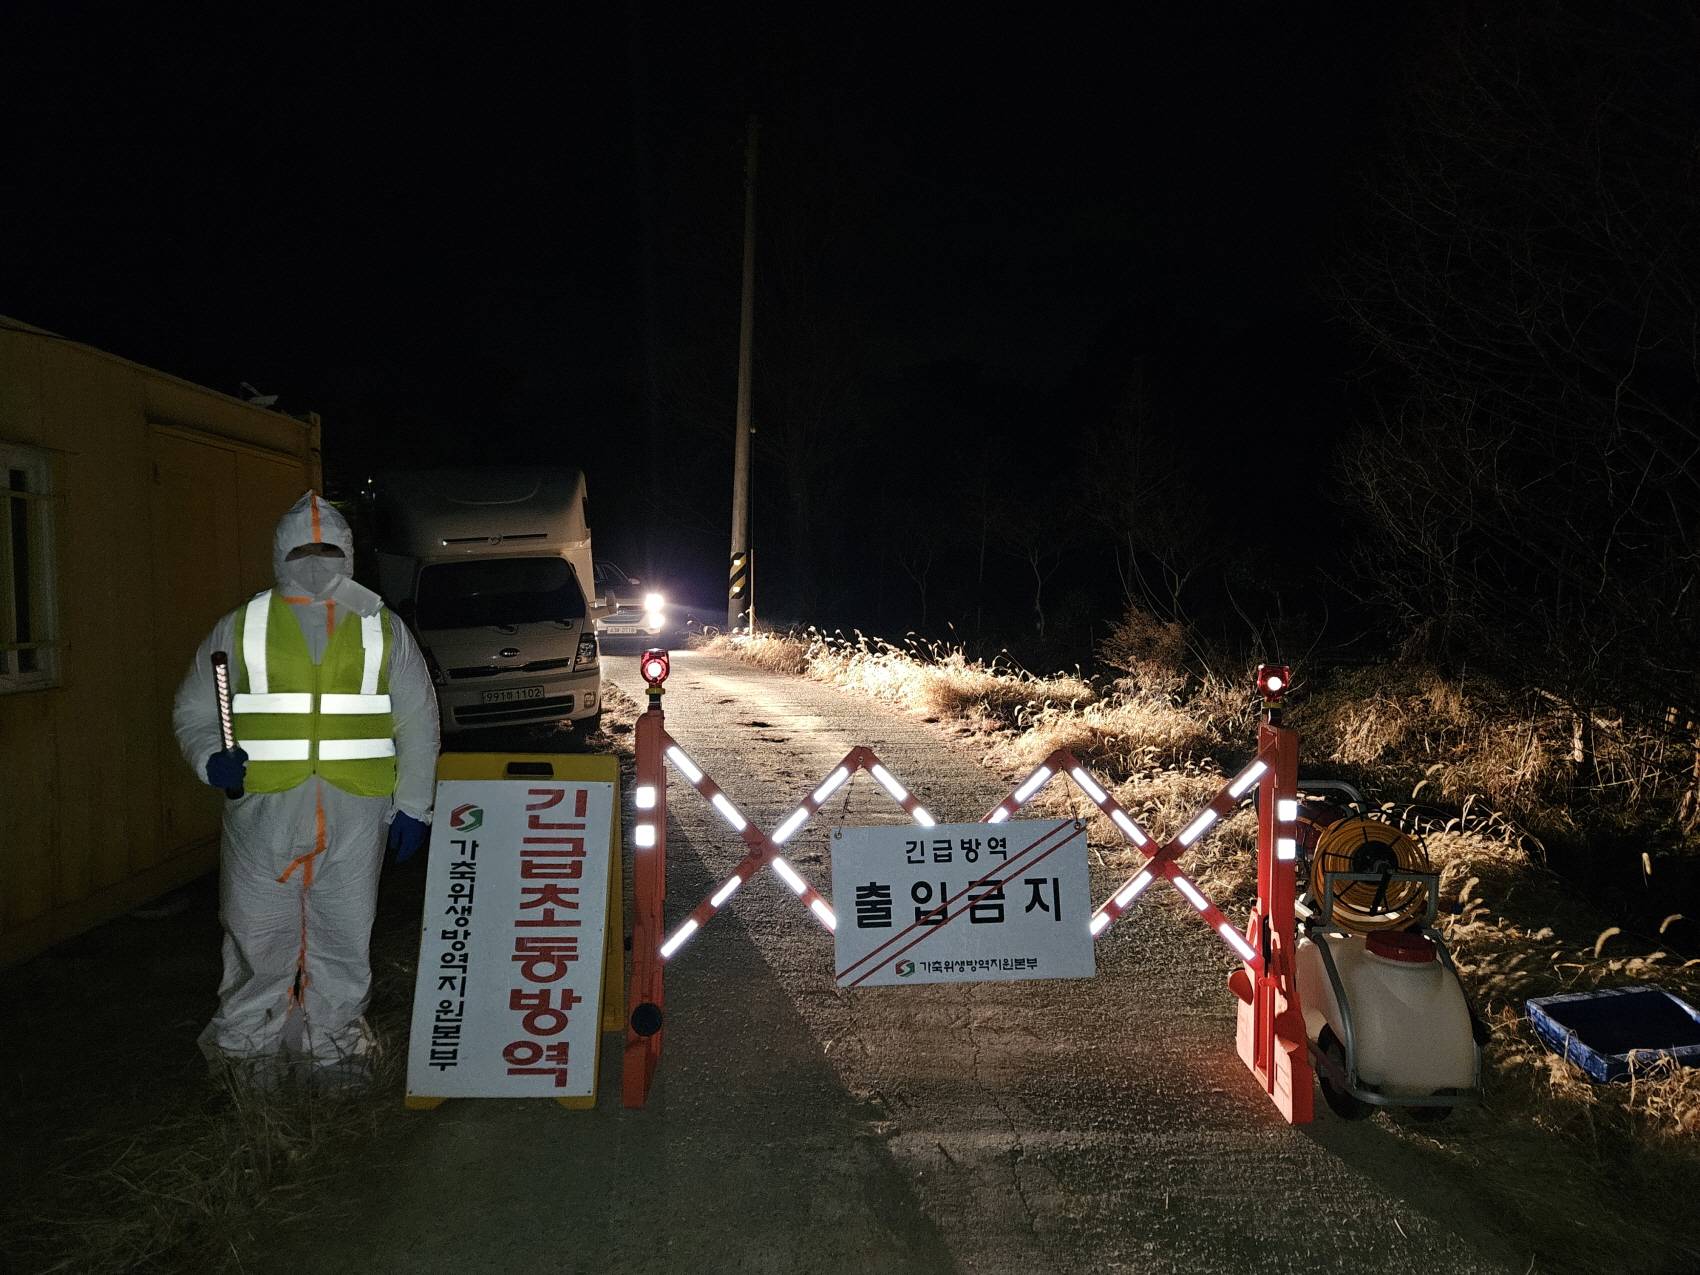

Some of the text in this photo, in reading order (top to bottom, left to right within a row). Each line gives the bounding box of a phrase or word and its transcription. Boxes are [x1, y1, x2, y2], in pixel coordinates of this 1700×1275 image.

[516, 688, 540, 700] 1102
[905, 836, 1009, 865] 긴급방역
[854, 877, 1062, 929] 출입금지
[428, 839, 480, 1072] 가축위생방역지원본부
[502, 788, 588, 1088] 긴급초동방역
[919, 957, 1039, 974] 가축위생방역지원본부
